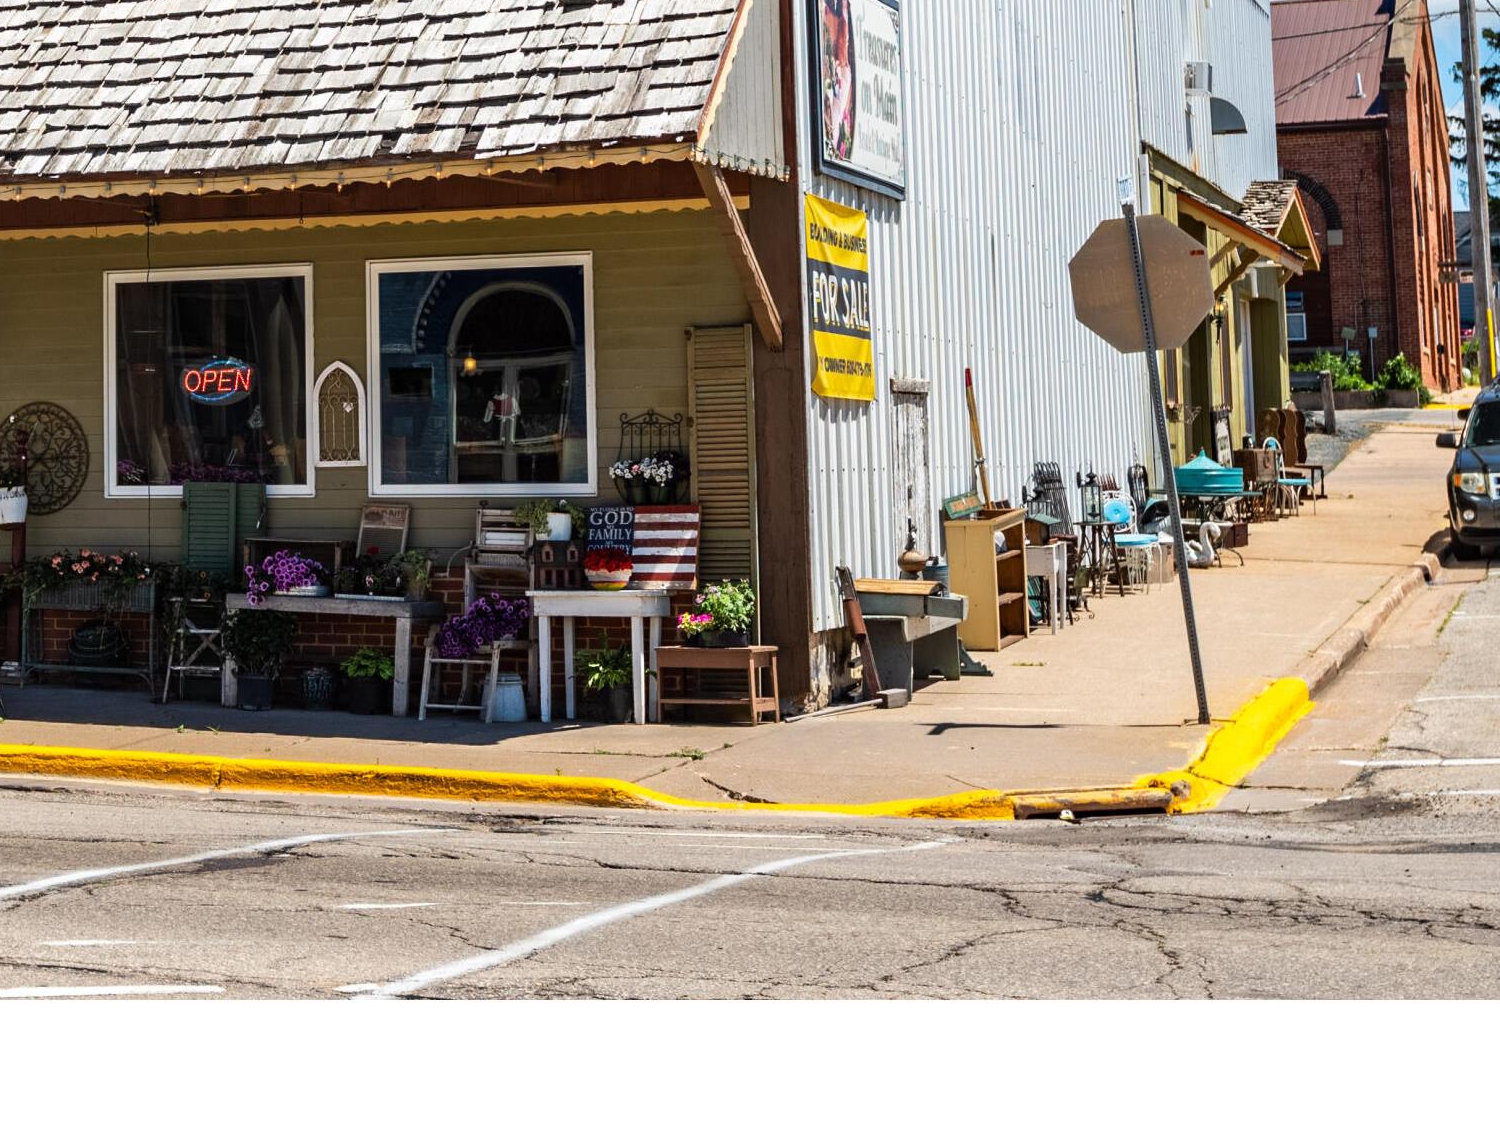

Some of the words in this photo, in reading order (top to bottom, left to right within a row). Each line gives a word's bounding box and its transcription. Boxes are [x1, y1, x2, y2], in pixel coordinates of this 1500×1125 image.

[855, 3, 898, 76] Treasures
[861, 79, 872, 116] on
[873, 72, 898, 127] Main
[810, 222, 838, 247] BUILDING
[843, 232, 867, 254] BUSINES
[812, 270, 840, 327] FOR
[841, 277, 870, 332] SALE
[184, 368, 252, 393] OPEN
[590, 511, 633, 525] GOD
[588, 528, 632, 541] FAMILY
